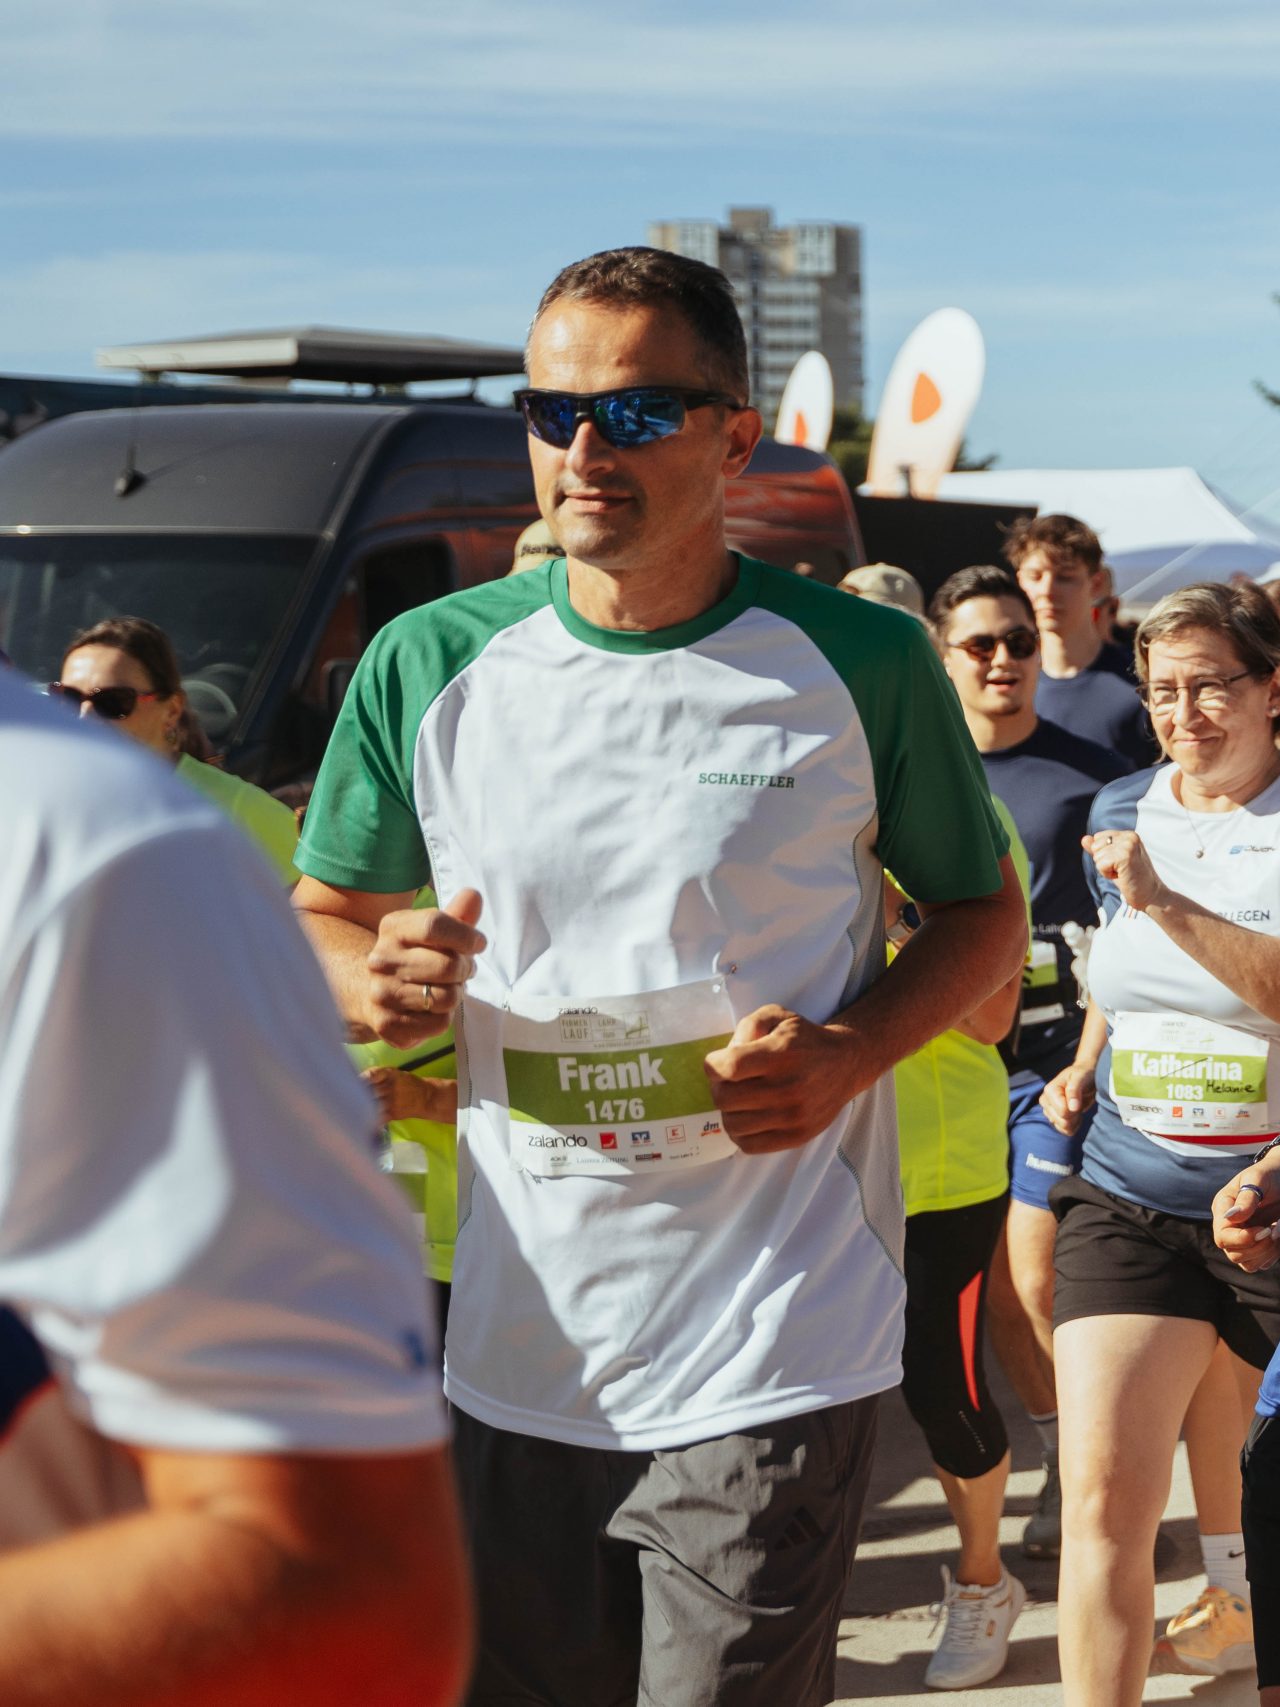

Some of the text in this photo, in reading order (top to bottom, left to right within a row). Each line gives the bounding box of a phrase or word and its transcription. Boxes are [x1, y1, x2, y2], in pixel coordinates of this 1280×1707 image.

[699, 773, 796, 788] SCHAEFFLER
[562, 1028, 589, 1040] LAUF
[558, 1053, 667, 1091] Frank
[1132, 1052, 1243, 1081] Katharina
[1166, 1083, 1204, 1101] 1083
[585, 1098, 645, 1123] 1476
[703, 1121, 719, 1132] dm
[528, 1133, 588, 1149] zalando
